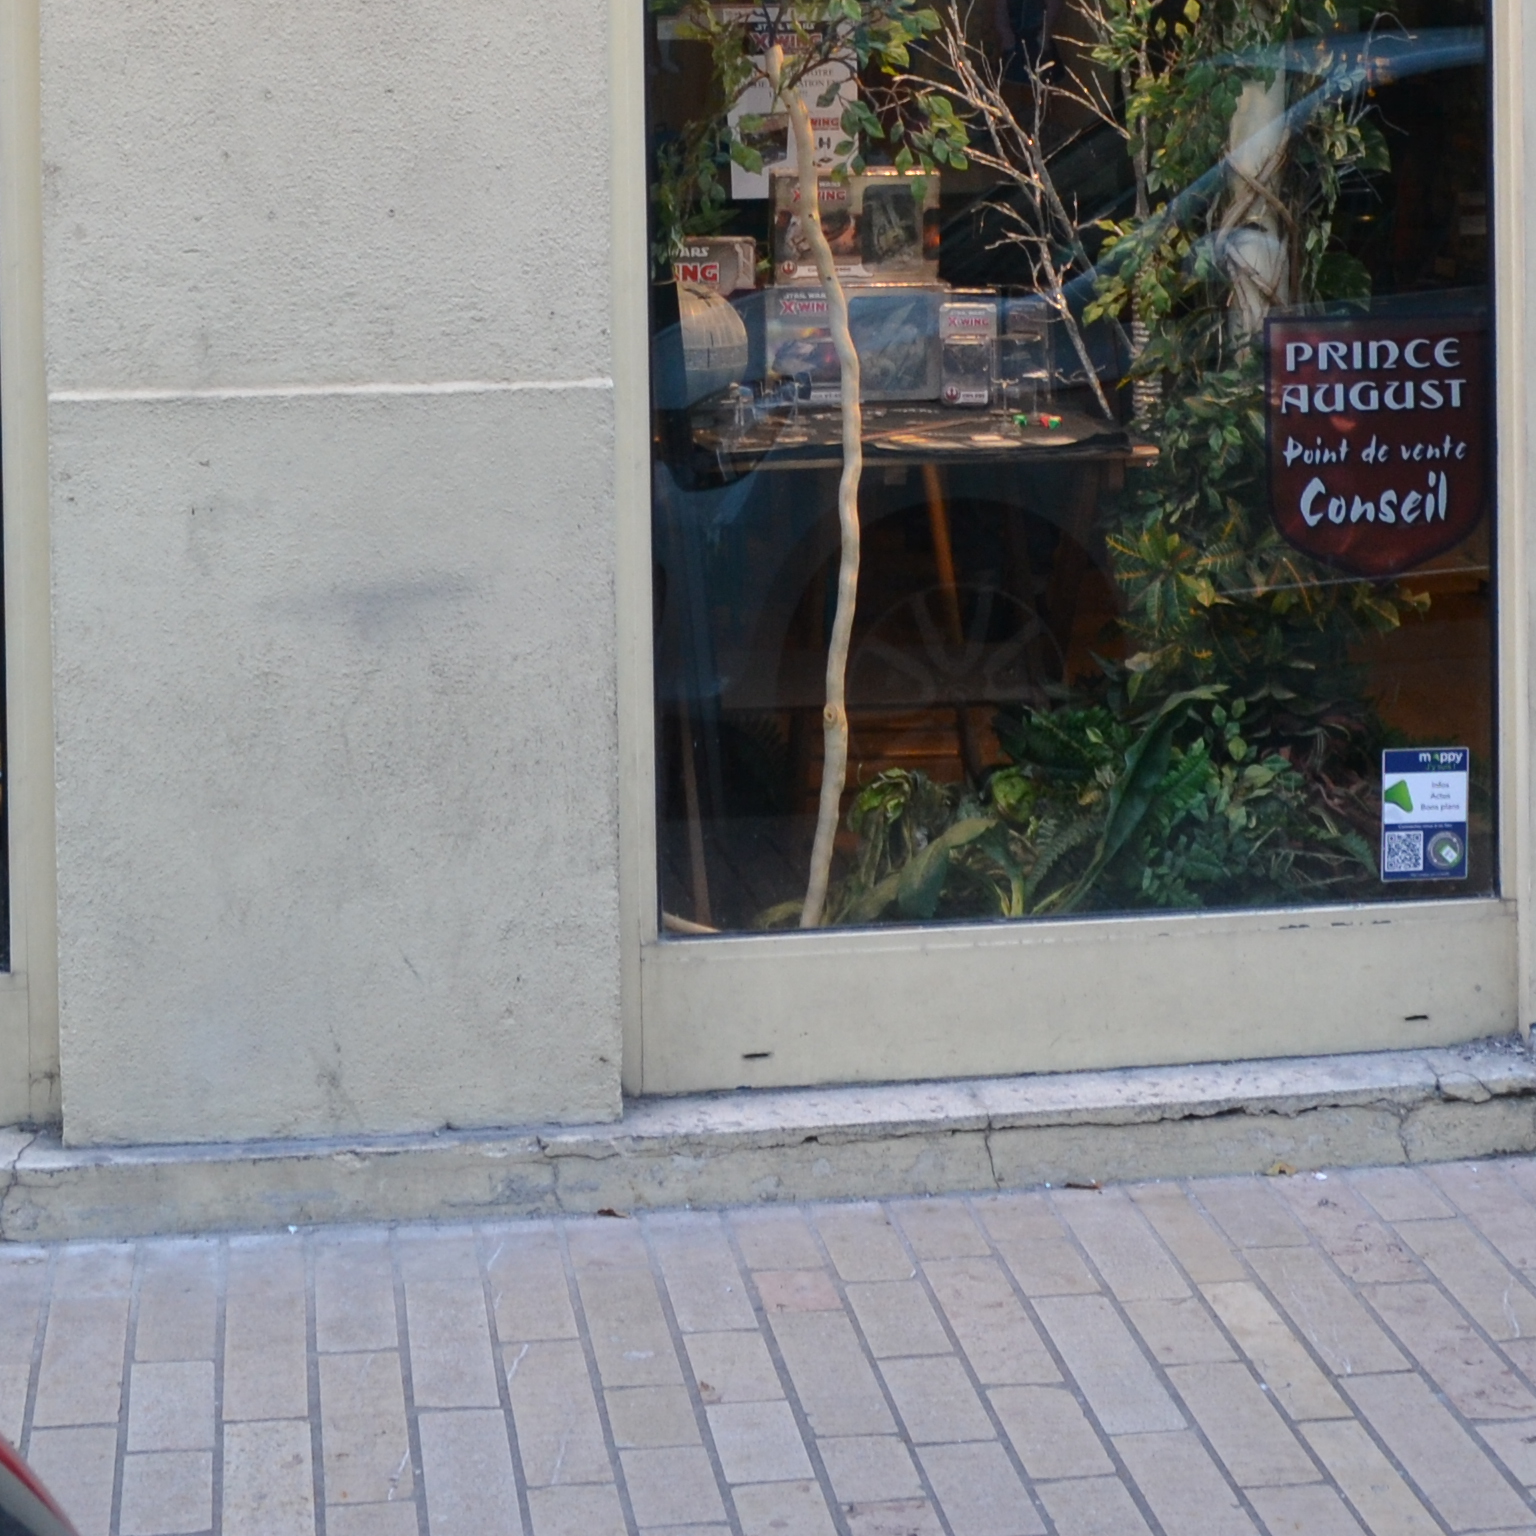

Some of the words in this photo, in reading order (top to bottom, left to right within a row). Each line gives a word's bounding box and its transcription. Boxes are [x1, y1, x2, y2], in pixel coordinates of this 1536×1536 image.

[1286, 338, 1460, 371] PRINCE
[1281, 379, 1466, 413] AUGUST
[1283, 436, 1349, 466] Point
[1362, 434, 1389, 464] de
[1401, 434, 1466, 461] vente
[1300, 470, 1447, 527] Conseil
